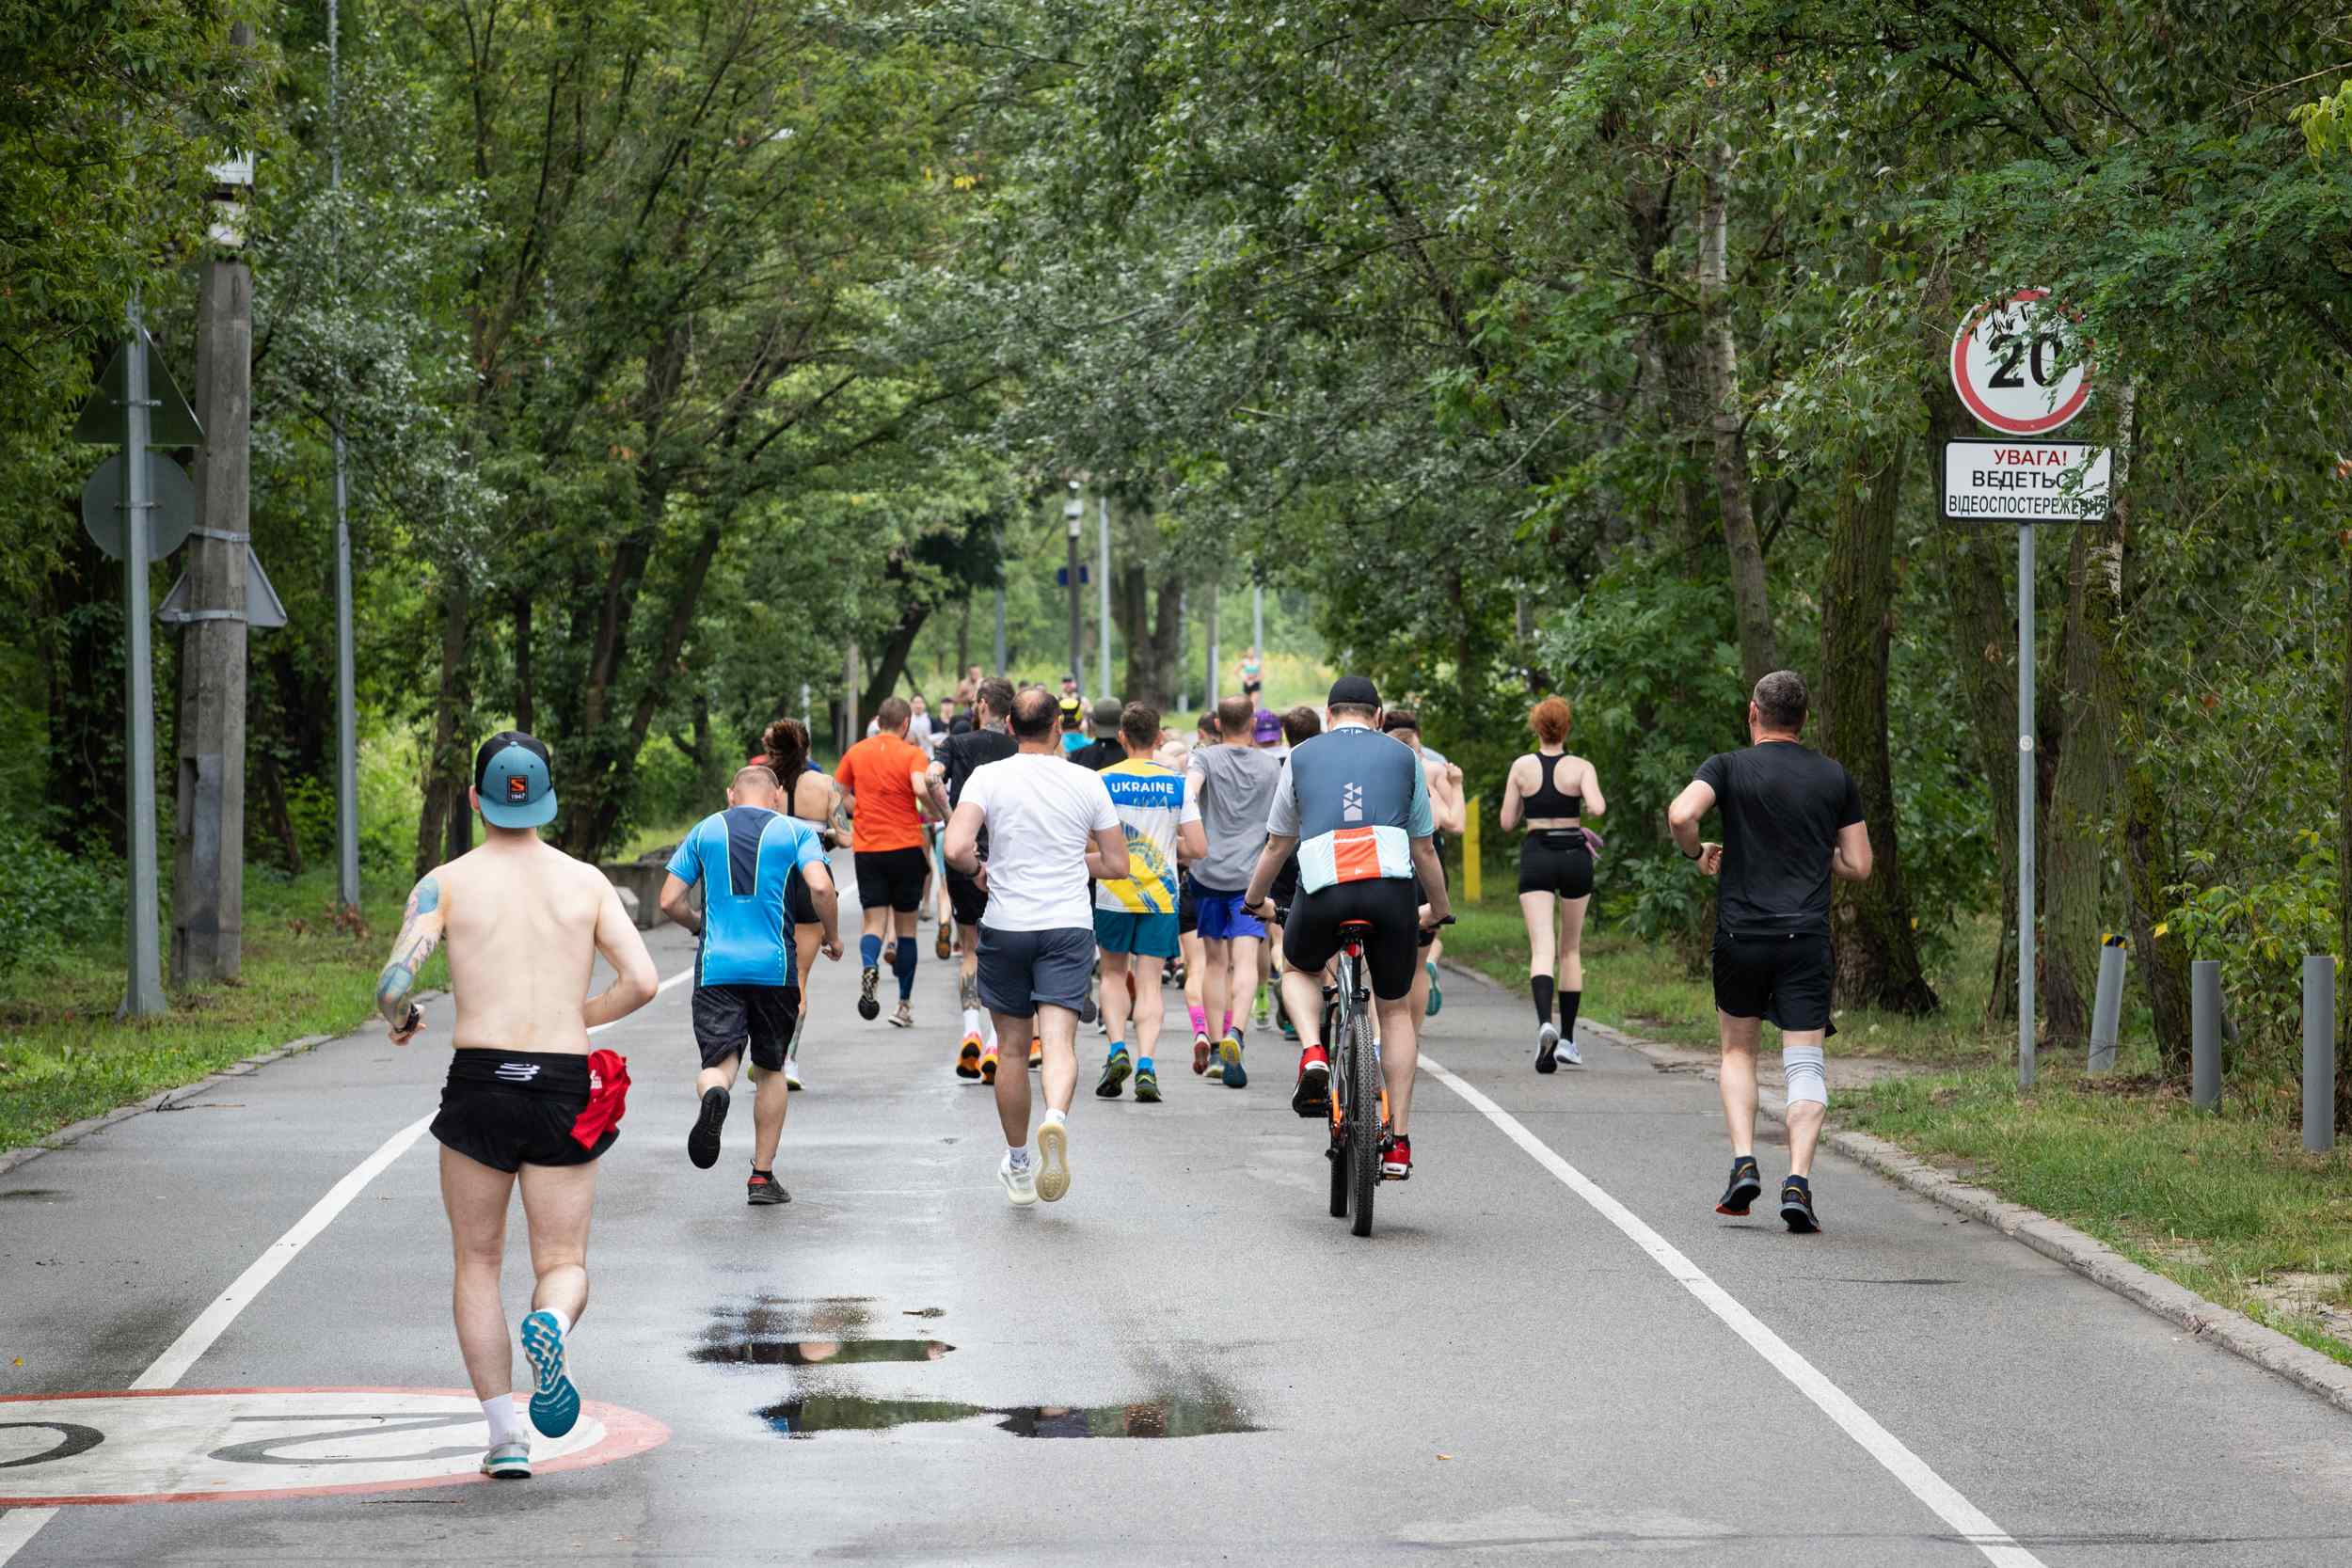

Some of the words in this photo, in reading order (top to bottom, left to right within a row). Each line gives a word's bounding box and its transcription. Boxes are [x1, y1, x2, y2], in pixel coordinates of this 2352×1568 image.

[1988, 332, 2064, 388] 20
[1994, 449, 2067, 467] УВАГА!
[1111, 781, 1175, 795] UKRAINE
